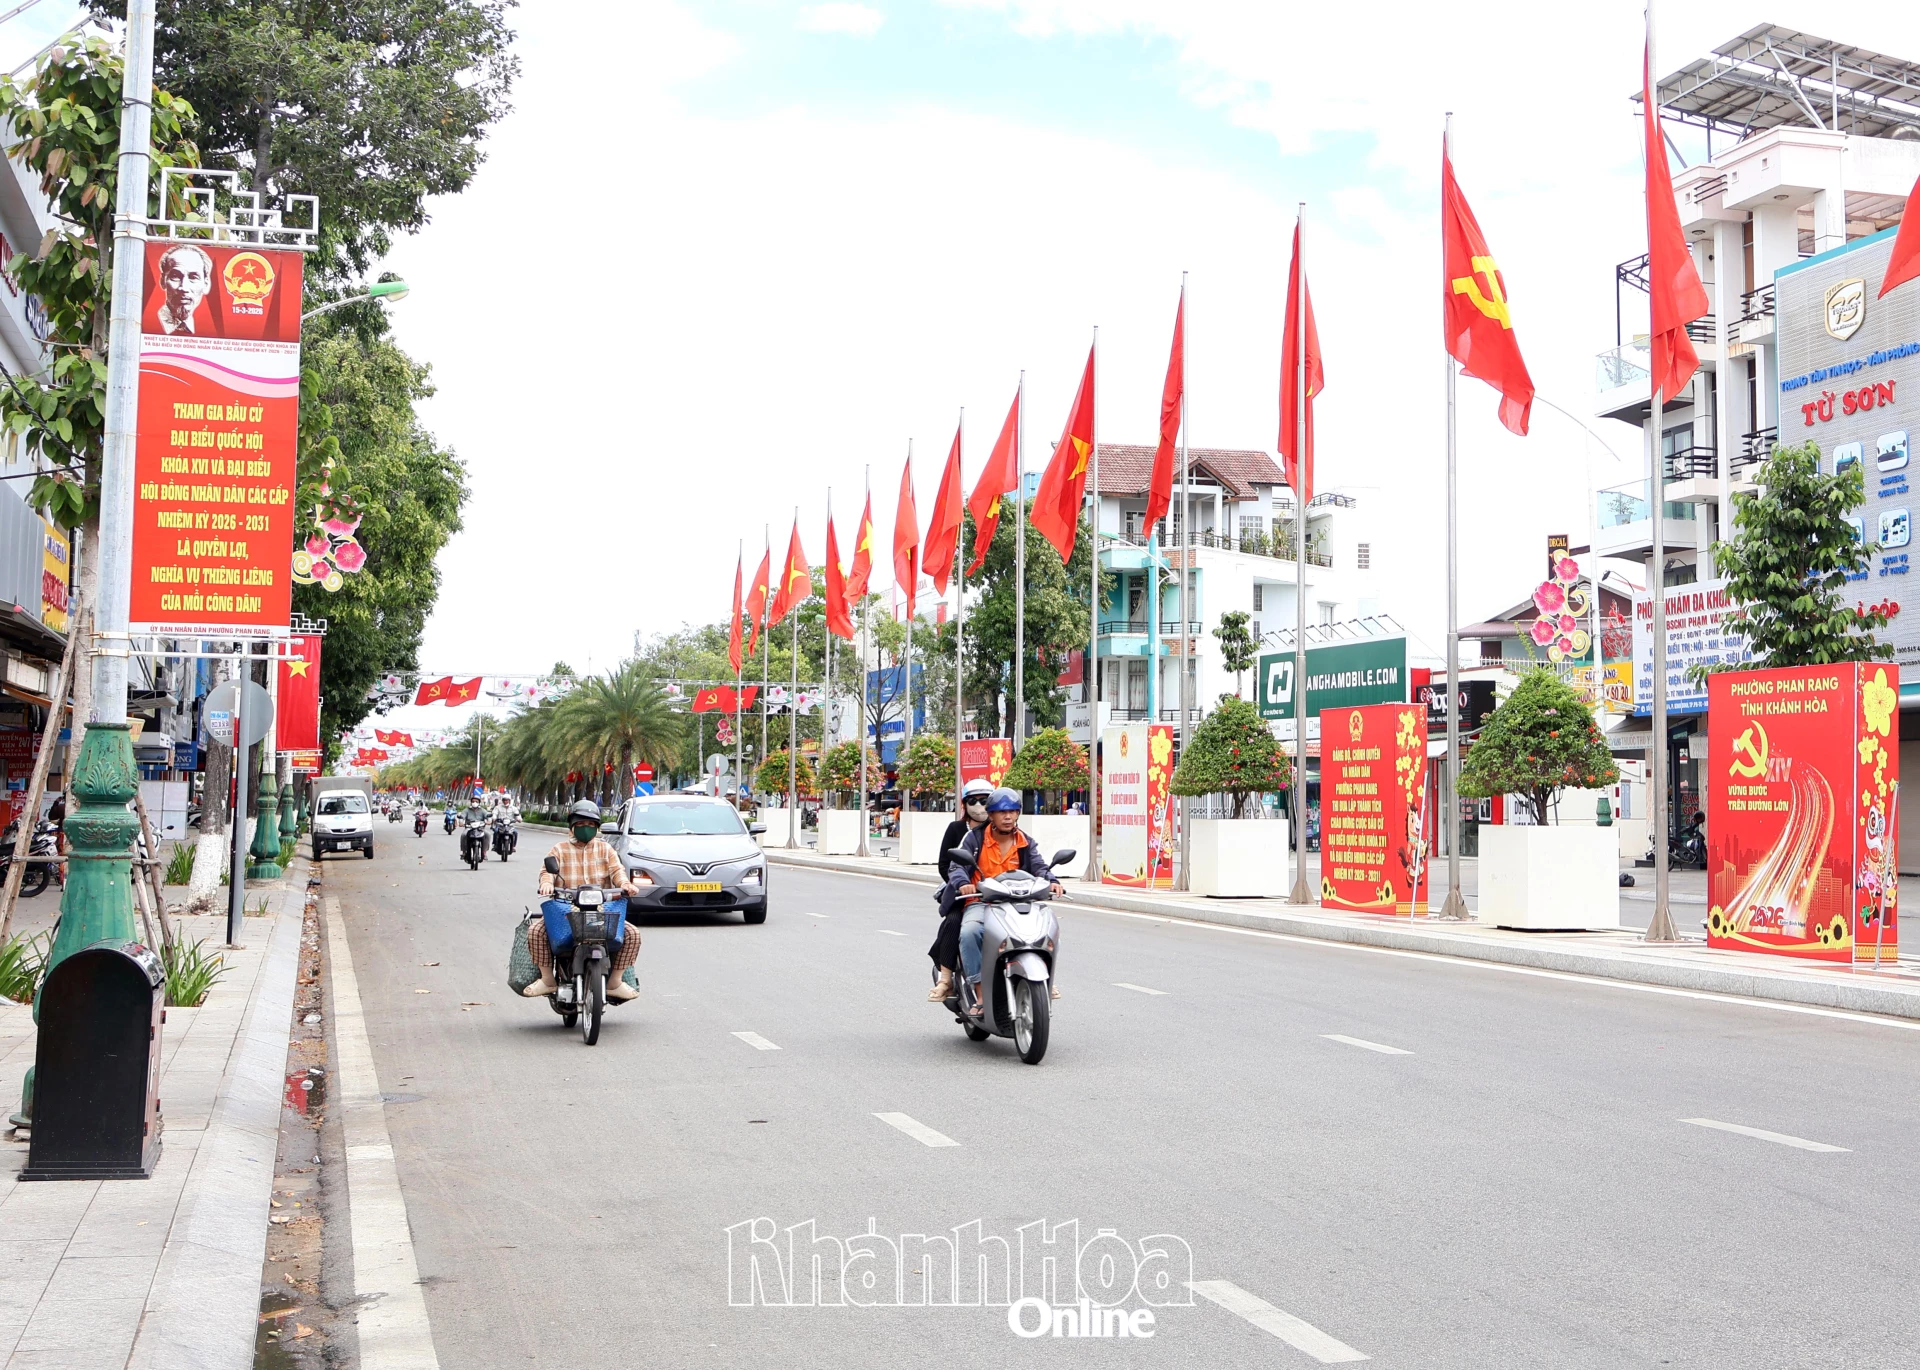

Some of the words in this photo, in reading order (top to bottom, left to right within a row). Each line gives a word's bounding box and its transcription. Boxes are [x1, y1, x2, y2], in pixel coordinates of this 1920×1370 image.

[232, 306, 264, 315] 15-3-2026
[1780, 374, 1809, 392] TRUNG
[1809, 369, 1828, 384] TÂM
[1828, 364, 1842, 378] TIN
[1843, 359, 1863, 375] HỌC
[1867, 351, 1887, 367] VĂN
[1887, 342, 1920, 361] PHÒNG
[174, 403, 204, 420] THAM
[206, 404, 223, 421] GIA
[226, 400, 246, 422] BẦU
[249, 402, 263, 422] CỬ
[1801, 389, 1838, 427] TỪ
[1842, 380, 1897, 417] SƠN
[170, 430, 188, 449] ĐẠI
[191, 425, 214, 447] BIỂU
[217, 427, 243, 451] QUỐC
[245, 430, 263, 453] HỘI
[161, 454, 188, 474] KHÓA
[191, 458, 208, 474] XVI
[211, 456, 225, 475] VÀ
[227, 459, 244, 478] ĐẠI
[247, 454, 271, 477] BIỂU
[140, 481, 158, 503] HỘI
[160, 478, 189, 501] ĐỒNG
[191, 483, 221, 503] NHÂN
[223, 484, 245, 503] DÂN
[248, 485, 267, 504] CÁC
[268, 483, 289, 505] CẤP
[157, 509, 193, 531] NHIỆM
[195, 510, 209, 529] KỲ
[211, 514, 236, 530] 2026
[245, 515, 269, 532] 2031
[177, 537, 191, 556] LÀ
[193, 534, 227, 559] QUYỀN
[229, 541, 249, 561] LỢI,
[1548, 537, 1567, 548] DECAL
[150, 564, 184, 583] NGHĨA
[186, 567, 200, 587] VỤ
[202, 565, 241, 585] THIÊNG
[243, 566, 273, 586] LIÊNG
[161, 590, 181, 611] CỦA
[183, 589, 204, 612] MỖI
[206, 592, 233, 612] CÔNG
[236, 593, 261, 613] DÂN!
[1637, 596, 1654, 620] PHÒ
[1665, 592, 1690, 616] KHÁM
[1693, 592, 1704, 611] ĐA
[174, 625, 192, 633] NHÂN
[208, 626, 234, 634] PHƯỜNG
[1688, 615, 1707, 630] PHẠM
[1667, 643, 1680, 656] ĐIỀU
[1693, 641, 1704, 654] NỘI
[1708, 638, 1719, 650] NHI
[1726, 651, 1740, 665] SIÊU
[1306, 667, 1398, 691] ANGHAMOBILE.COM
[1731, 678, 1774, 697] PHƯỜNG
[1776, 679, 1805, 695] PHAN
[1807, 676, 1839, 693] RANG
[1621, 685, 1629, 701] 20
[1740, 699, 1763, 716] TỈNH
[1766, 697, 1802, 715] KHÁNH
[1804, 696, 1828, 713] HÒA
[1764, 757, 1793, 783] XIV
[1728, 784, 1747, 796] VỮNG
[1748, 784, 1768, 796] BƯỚC
[1728, 799, 1746, 811] TRÊN
[1747, 799, 1773, 812] ĐƯỜNG
[1773, 799, 1789, 812] LỚN
